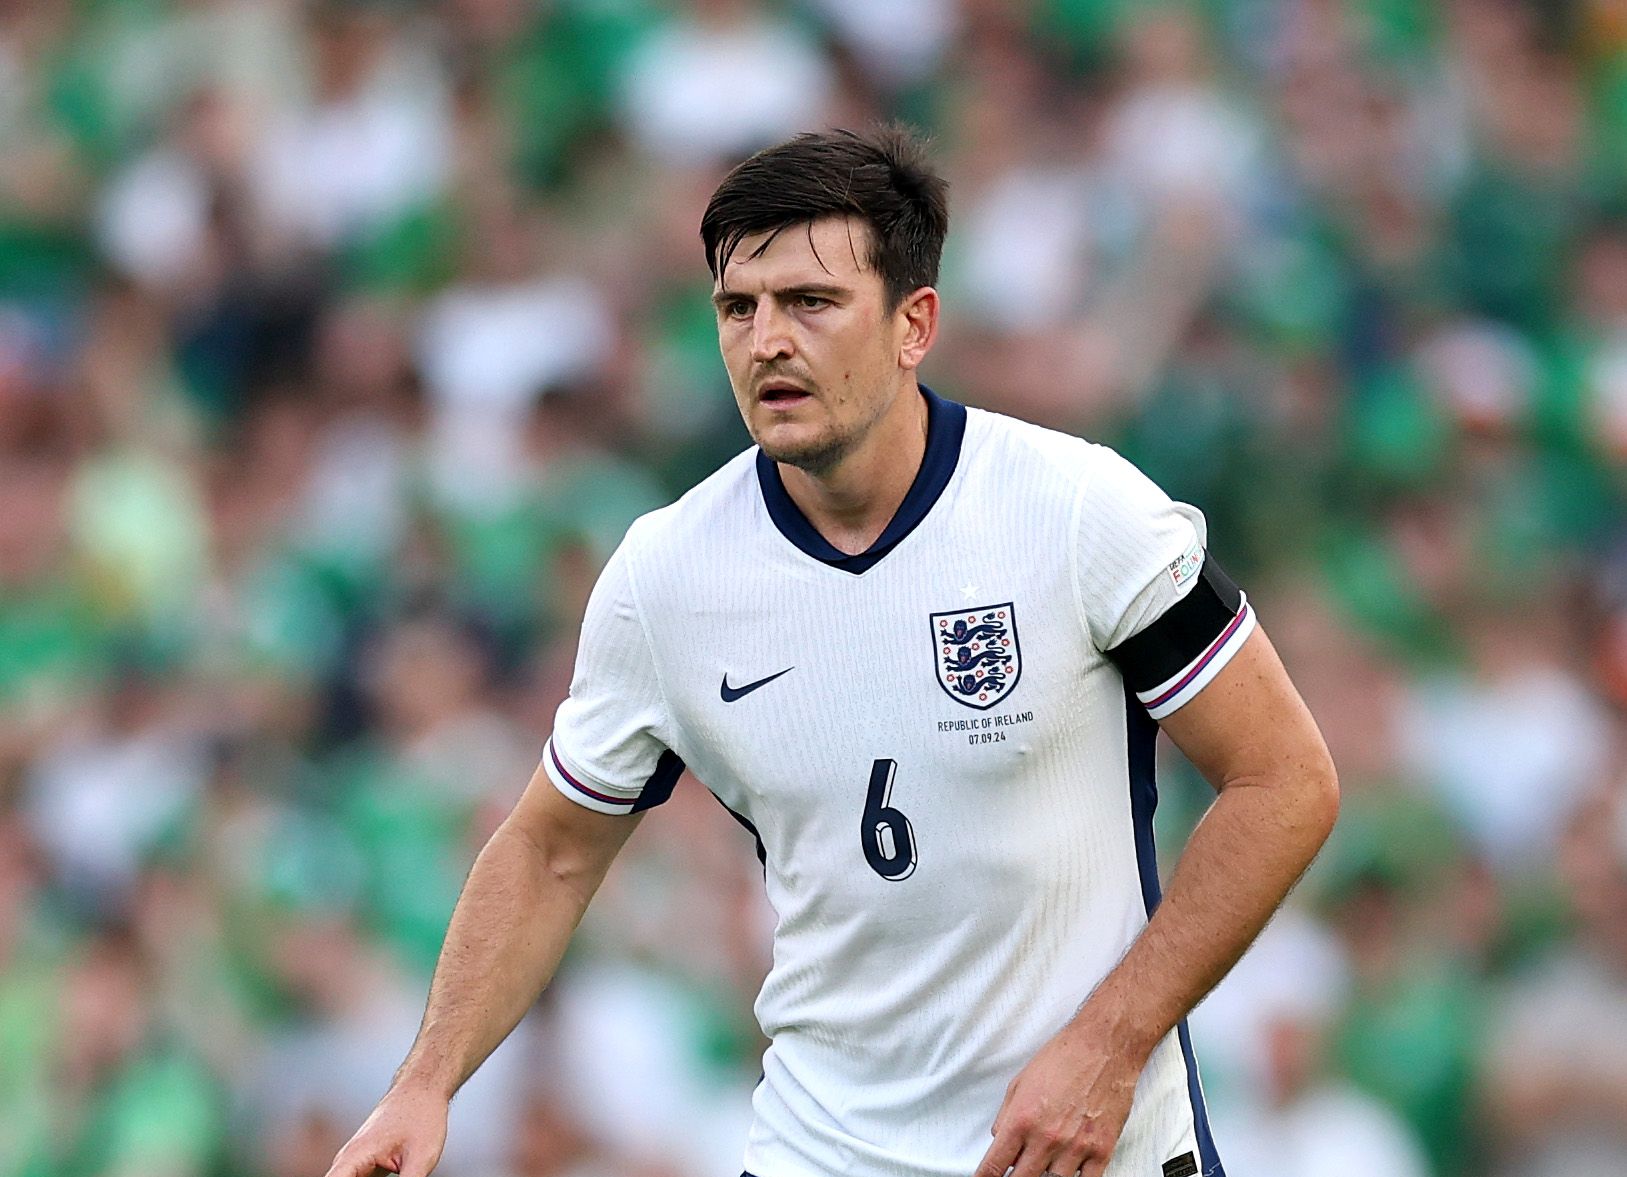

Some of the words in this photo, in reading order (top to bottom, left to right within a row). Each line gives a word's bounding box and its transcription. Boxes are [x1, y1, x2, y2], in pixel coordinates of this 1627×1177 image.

[937, 719, 979, 732] REPUBLIC
[981, 717, 992, 729] OF
[994, 711, 1034, 727] IRELAND
[968, 731, 1006, 745] 07.09.24
[860, 758, 918, 882] 6
